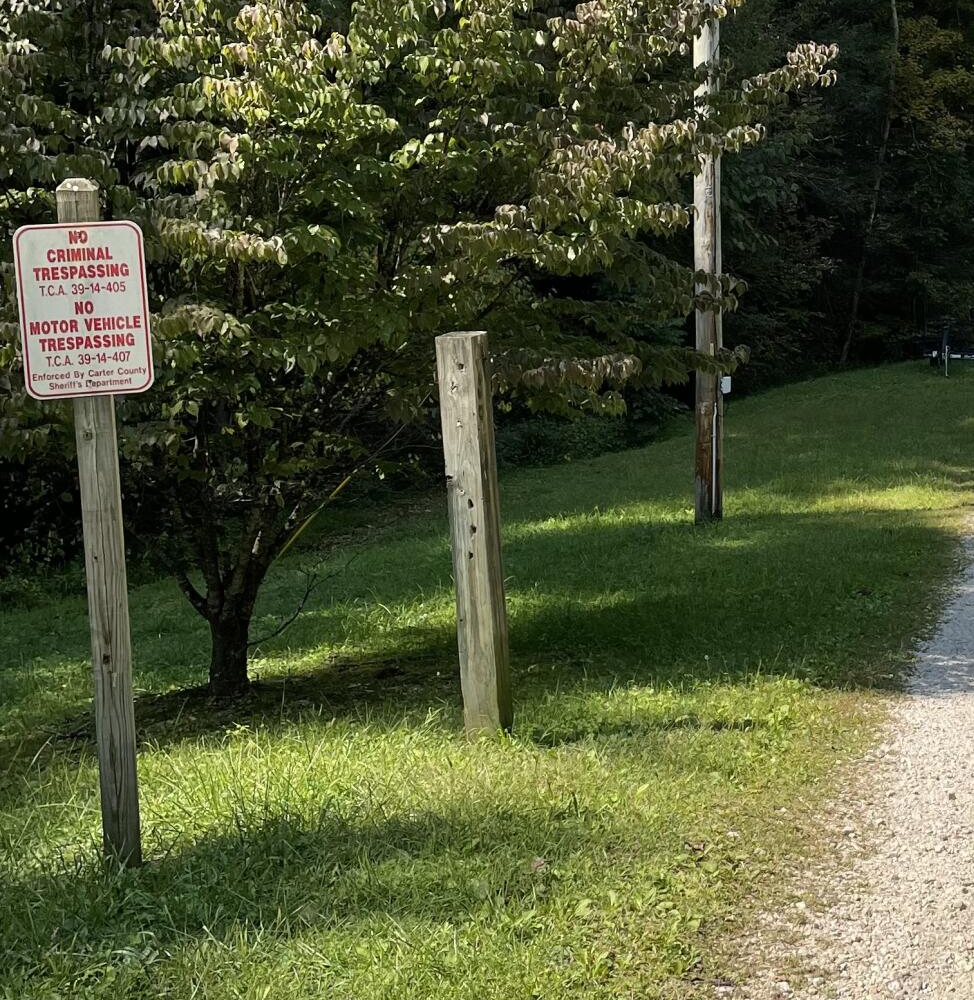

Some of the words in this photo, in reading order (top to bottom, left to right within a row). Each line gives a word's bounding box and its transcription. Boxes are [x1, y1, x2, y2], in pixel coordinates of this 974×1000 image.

[68, 231, 88, 244] NO
[47, 247, 112, 263] CRIMINAL
[33, 263, 129, 281] TRESPASSING
[39, 285, 67, 296] T.C.A.
[72, 282, 126, 295] 39-14-405
[74, 301, 94, 315] NO
[30, 320, 78, 335] MOTOR
[85, 316, 141, 332] VEHICLE
[39, 333, 135, 352] TRESPASSING
[46, 356, 73, 367] T.C.A.
[78, 351, 131, 364] 39-14-407
[32, 372, 70, 381] Enforced
[118, 367, 147, 376] County
[49, 380, 82, 390] Sheriff's
